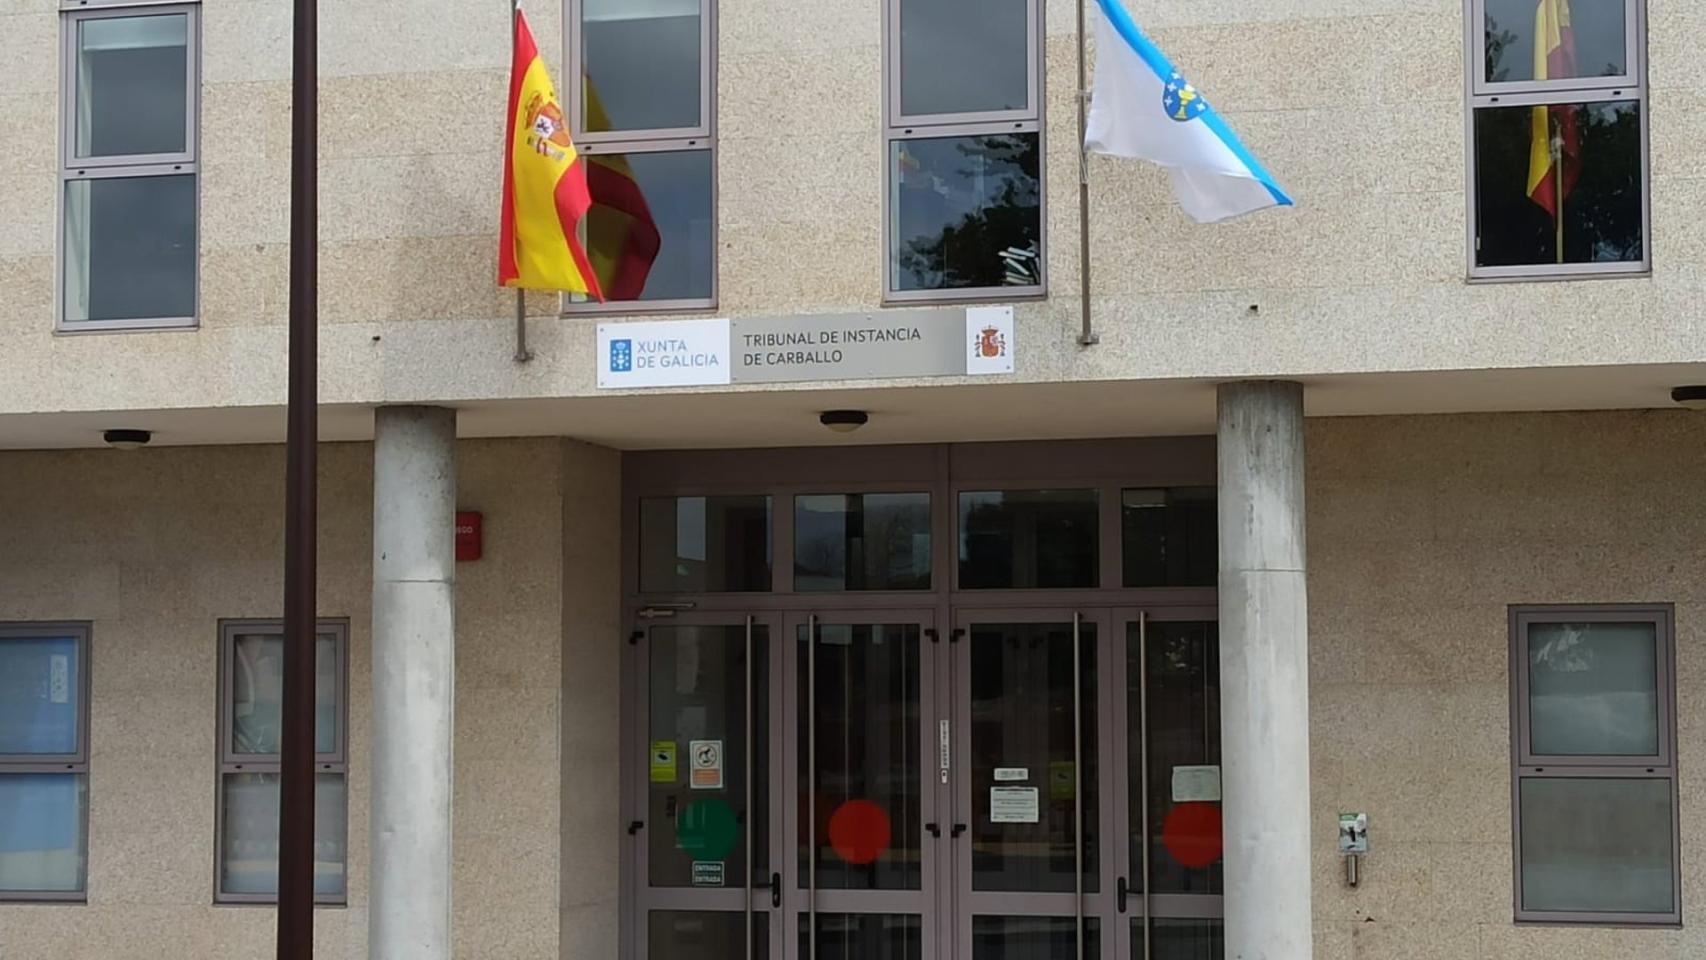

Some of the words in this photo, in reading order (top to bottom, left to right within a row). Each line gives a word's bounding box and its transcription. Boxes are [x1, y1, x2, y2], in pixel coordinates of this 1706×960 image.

[743, 332, 816, 347] TRIBUNAL
[820, 331, 839, 345] DE
[843, 328, 921, 343] INSTANCIA
[637, 339, 687, 354] XUNTA
[637, 355, 656, 369] DE
[660, 353, 719, 368] GALICIA
[743, 353, 762, 366] DE
[766, 350, 843, 365] CARBALLO
